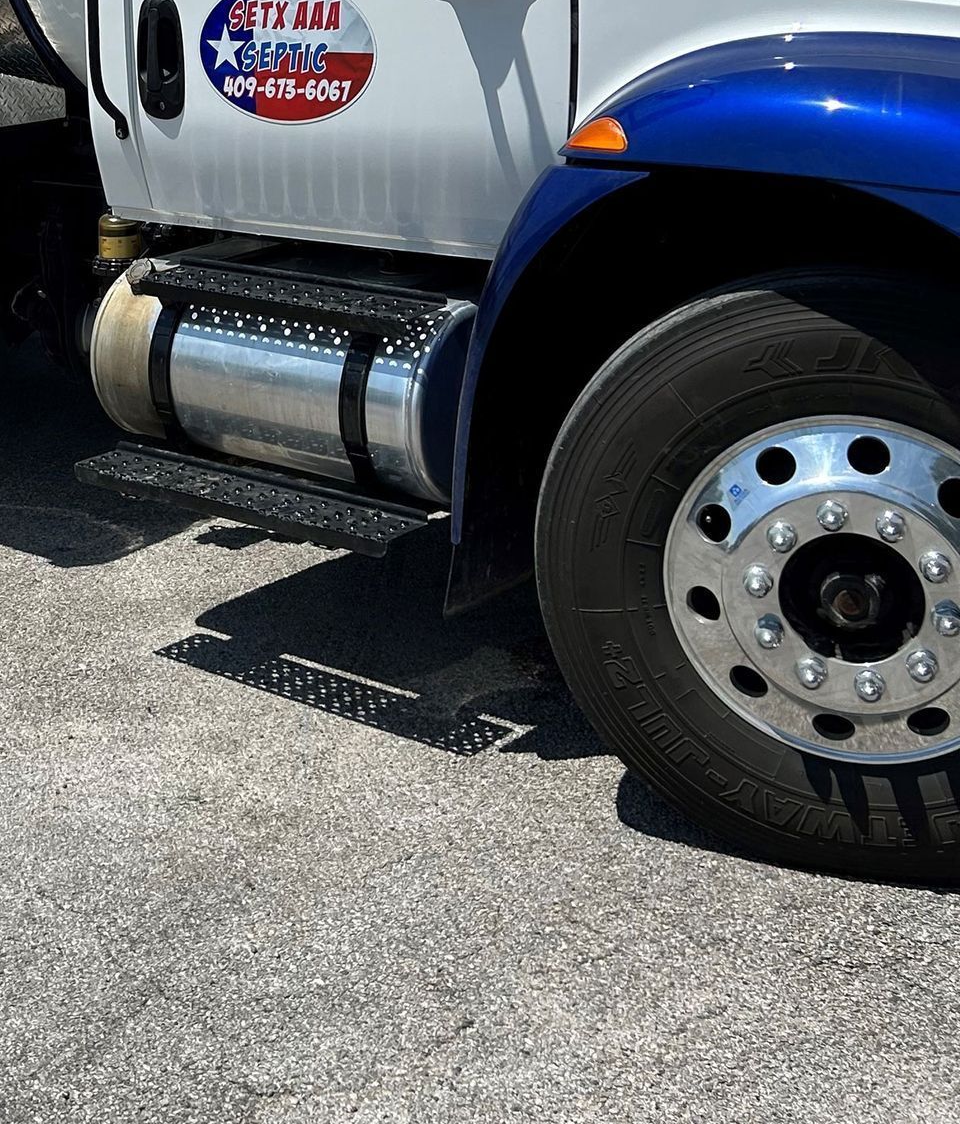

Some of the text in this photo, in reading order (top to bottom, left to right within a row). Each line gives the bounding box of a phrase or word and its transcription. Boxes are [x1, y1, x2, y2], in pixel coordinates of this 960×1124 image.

[229, 0, 342, 31] SETX AAA
[242, 41, 328, 73] SEPTIC
[223, 76, 352, 101] 409-673-6067
